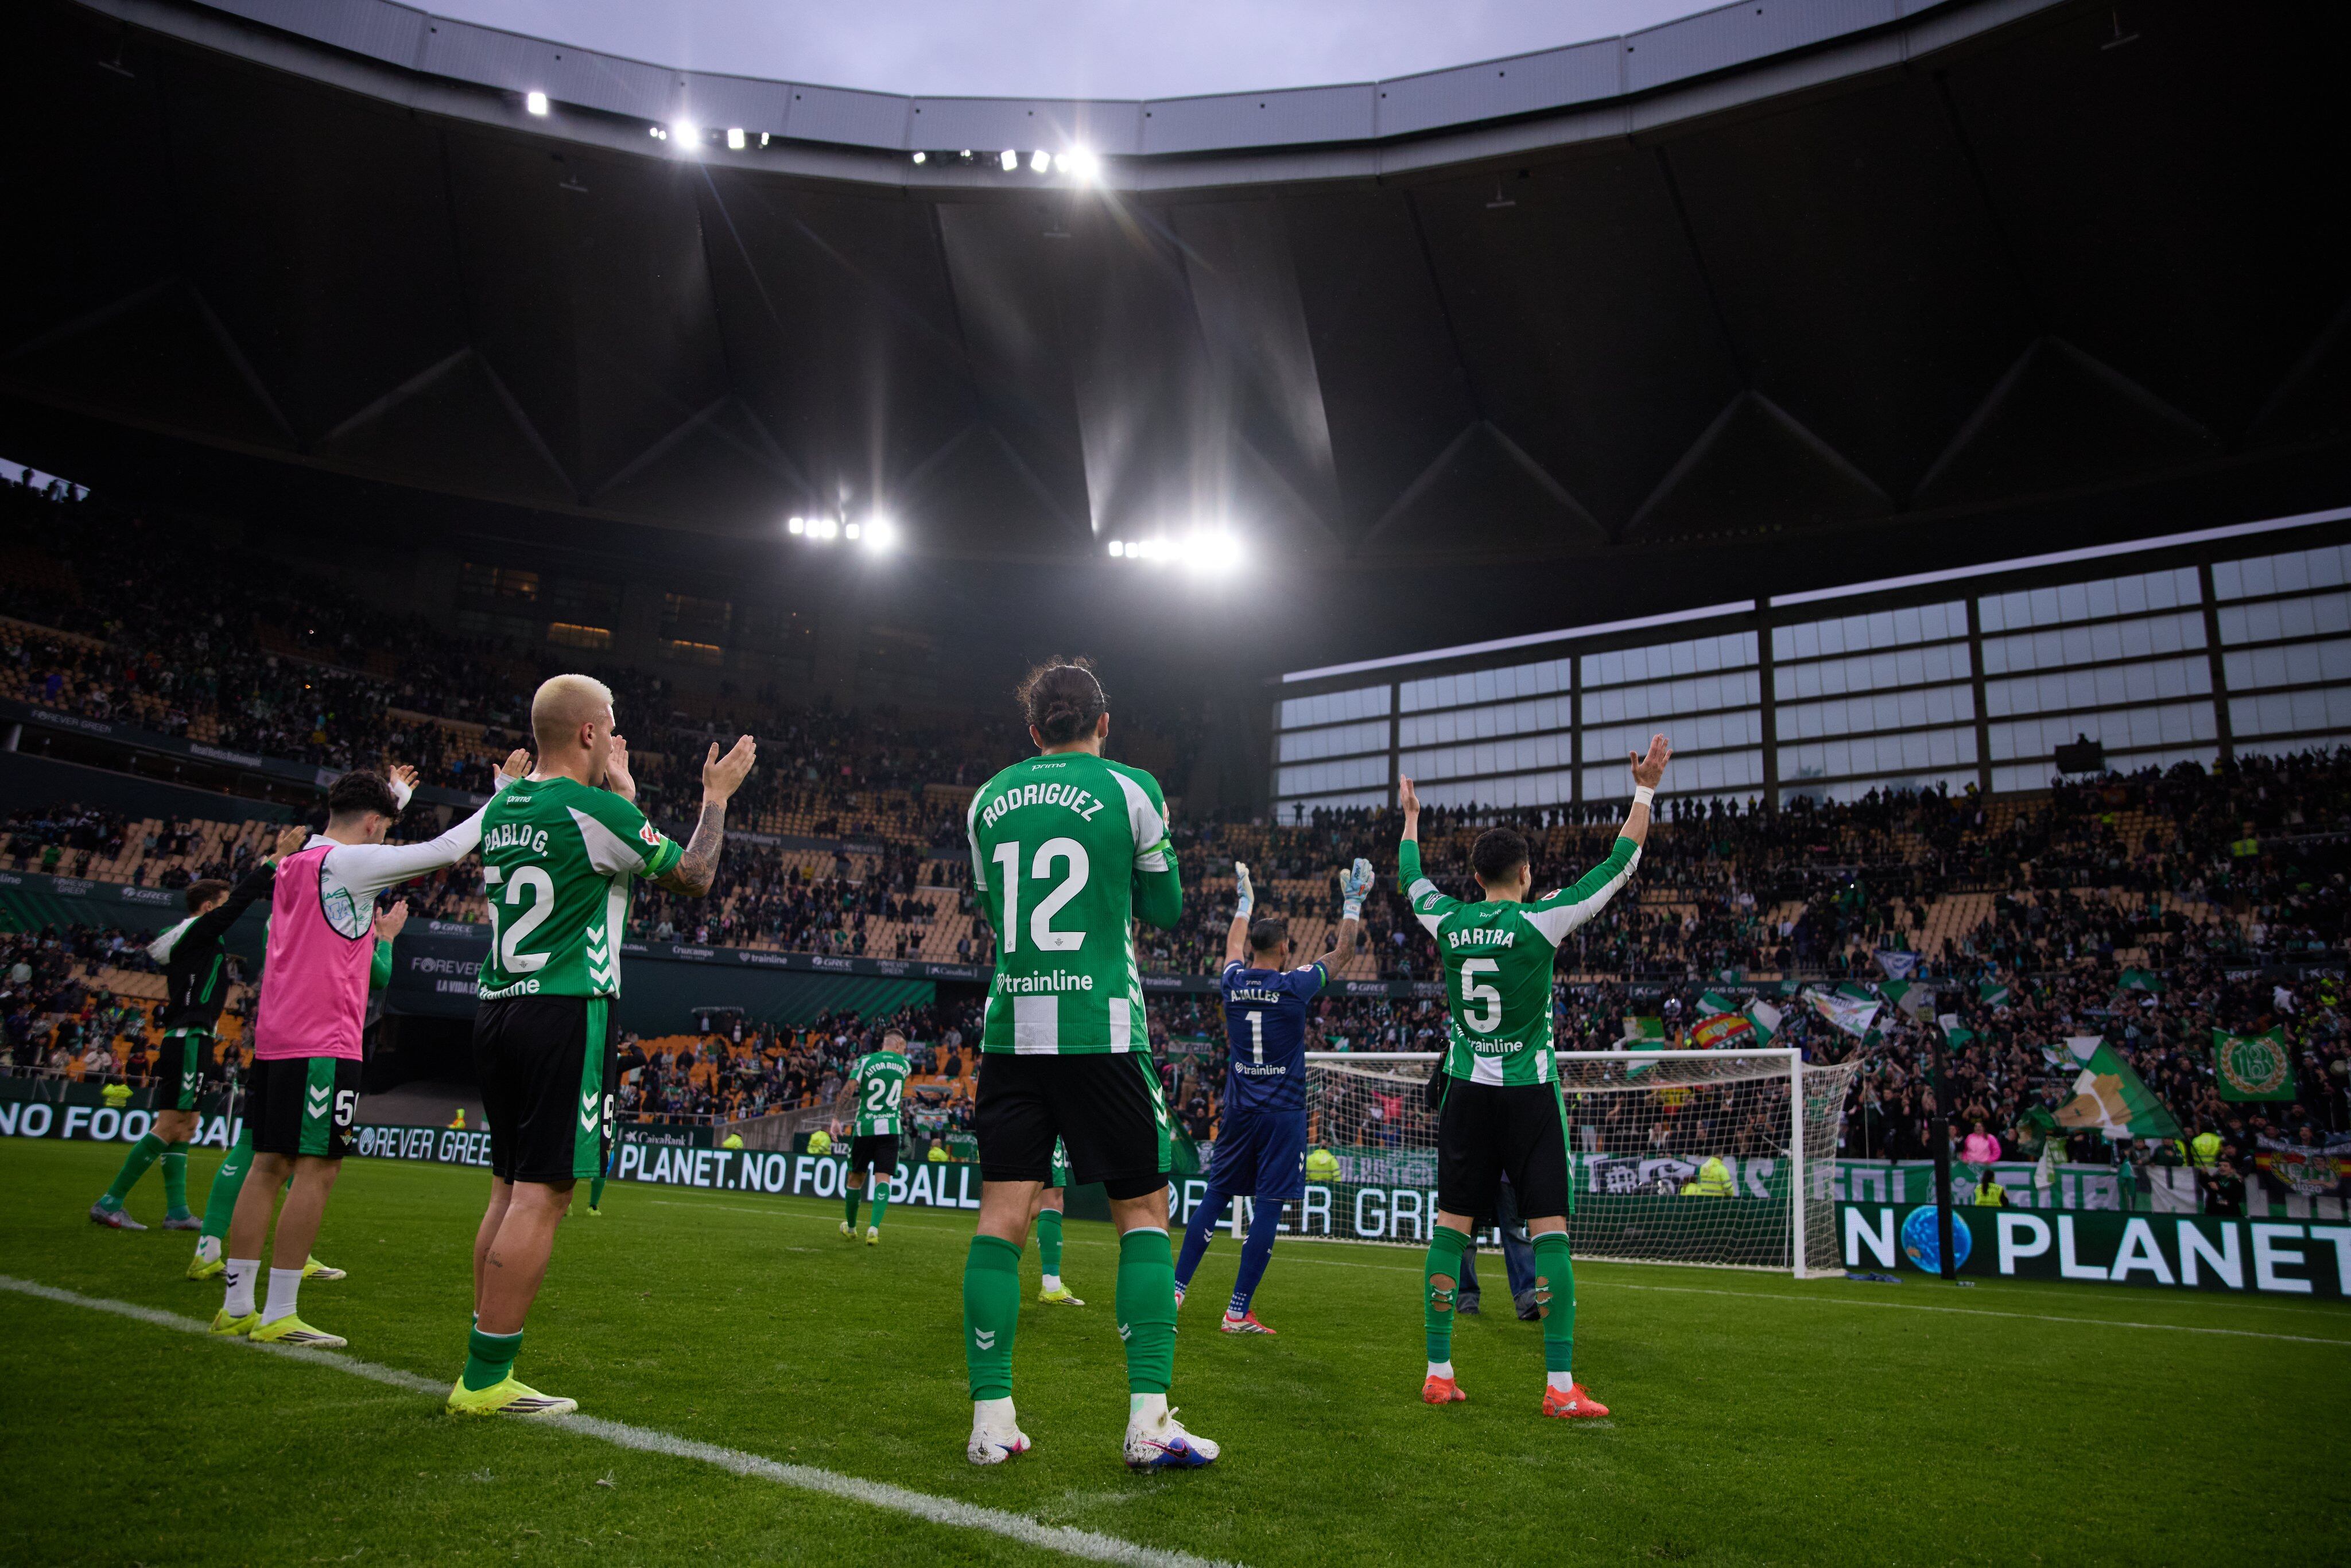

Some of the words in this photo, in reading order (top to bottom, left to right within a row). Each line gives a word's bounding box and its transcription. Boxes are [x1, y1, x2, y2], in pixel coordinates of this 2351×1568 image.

[81, 720, 112, 733] GREEN
[1031, 763, 1066, 771] prima
[507, 795, 532, 805] prima
[982, 783, 1104, 829] RODRIGUEZ
[484, 824, 533, 856] PABLO
[532, 830, 549, 857] G.
[992, 837, 1090, 954] 12
[1448, 928, 1515, 949] BARTRA
[673, 945, 714, 957] Cruzcampo
[751, 953, 788, 965] trainline
[1004, 969, 1093, 992] trainline
[1460, 958, 1502, 1034] 5
[1244, 1011, 1263, 1064] 1
[1467, 1038, 1523, 1053] trainline
[864, 1062, 886, 1078] AITOR
[886, 1062, 907, 1079] RUIBA
[1243, 1064, 1286, 1076] trainline
[866, 1078, 903, 1112] 24
[335, 1090, 360, 1127] 5
[437, 1131, 494, 1167] GREE
[637, 1131, 686, 1146] CaixaBank
[618, 1144, 735, 1189] PLANET.
[740, 1151, 787, 1193] NO
[1996, 1212, 2351, 1296] PLANET
